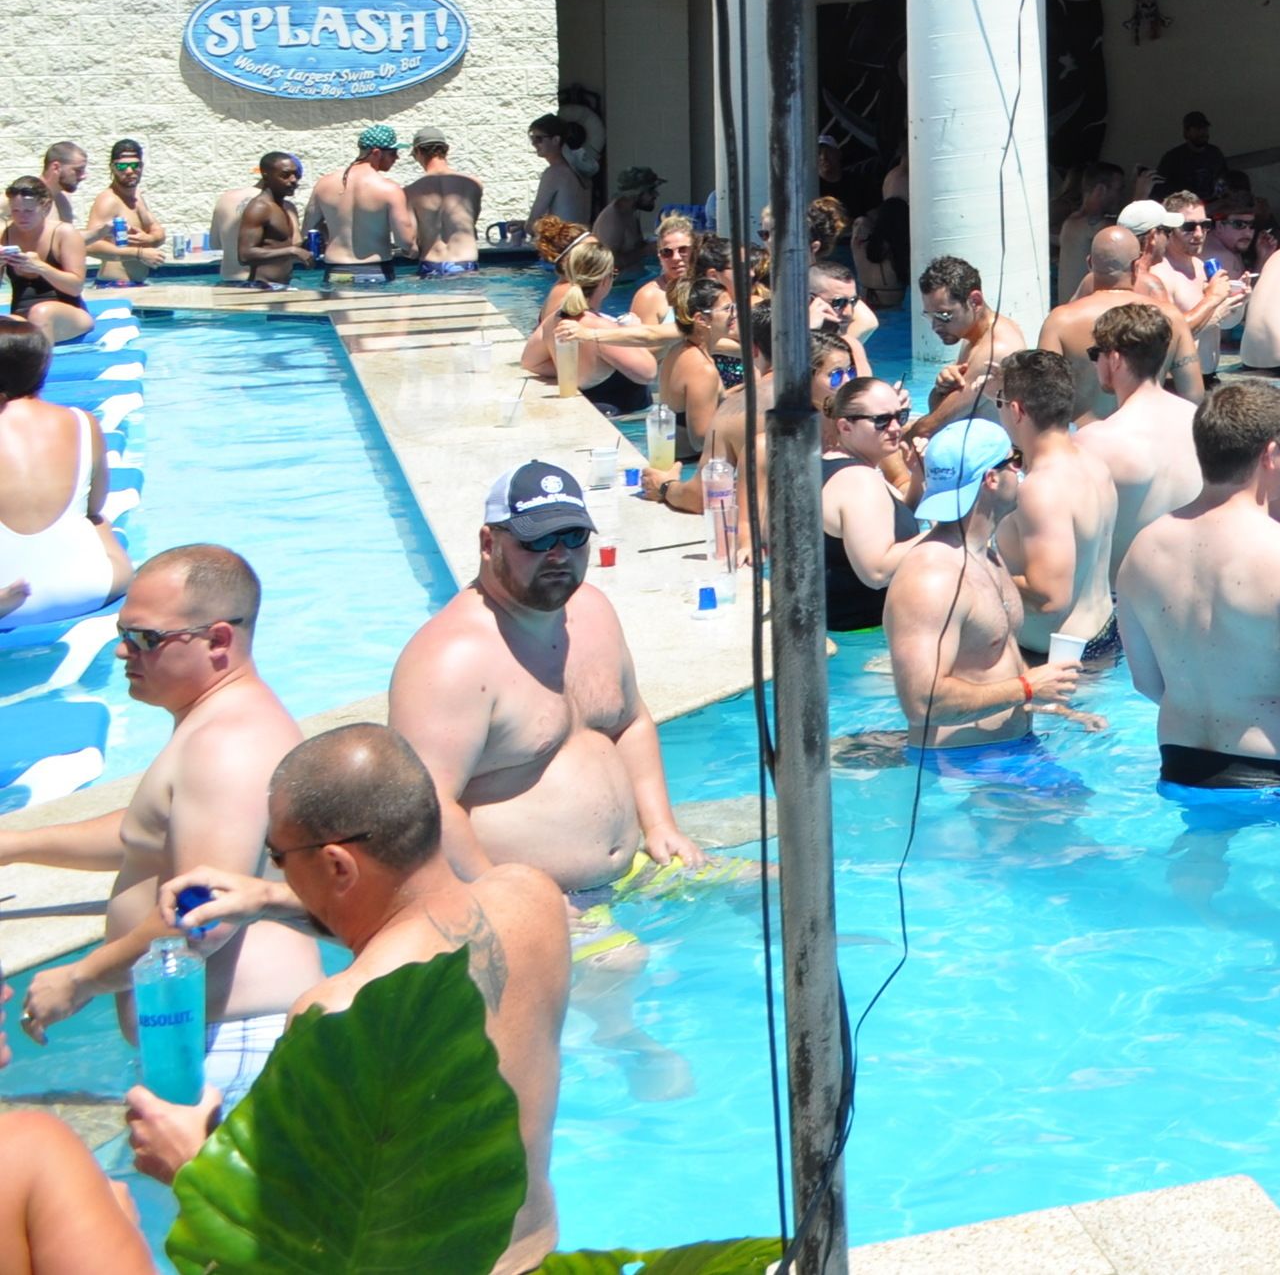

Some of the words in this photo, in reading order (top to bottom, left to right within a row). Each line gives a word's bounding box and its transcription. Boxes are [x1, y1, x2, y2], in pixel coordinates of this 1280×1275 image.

[205, 5, 449, 57] SPLASH!
[234, 55, 284, 79] World's
[286, 68, 336, 86] Largest
[400, 55, 422, 72] Bar
[351, 82, 376, 94] Ohio
